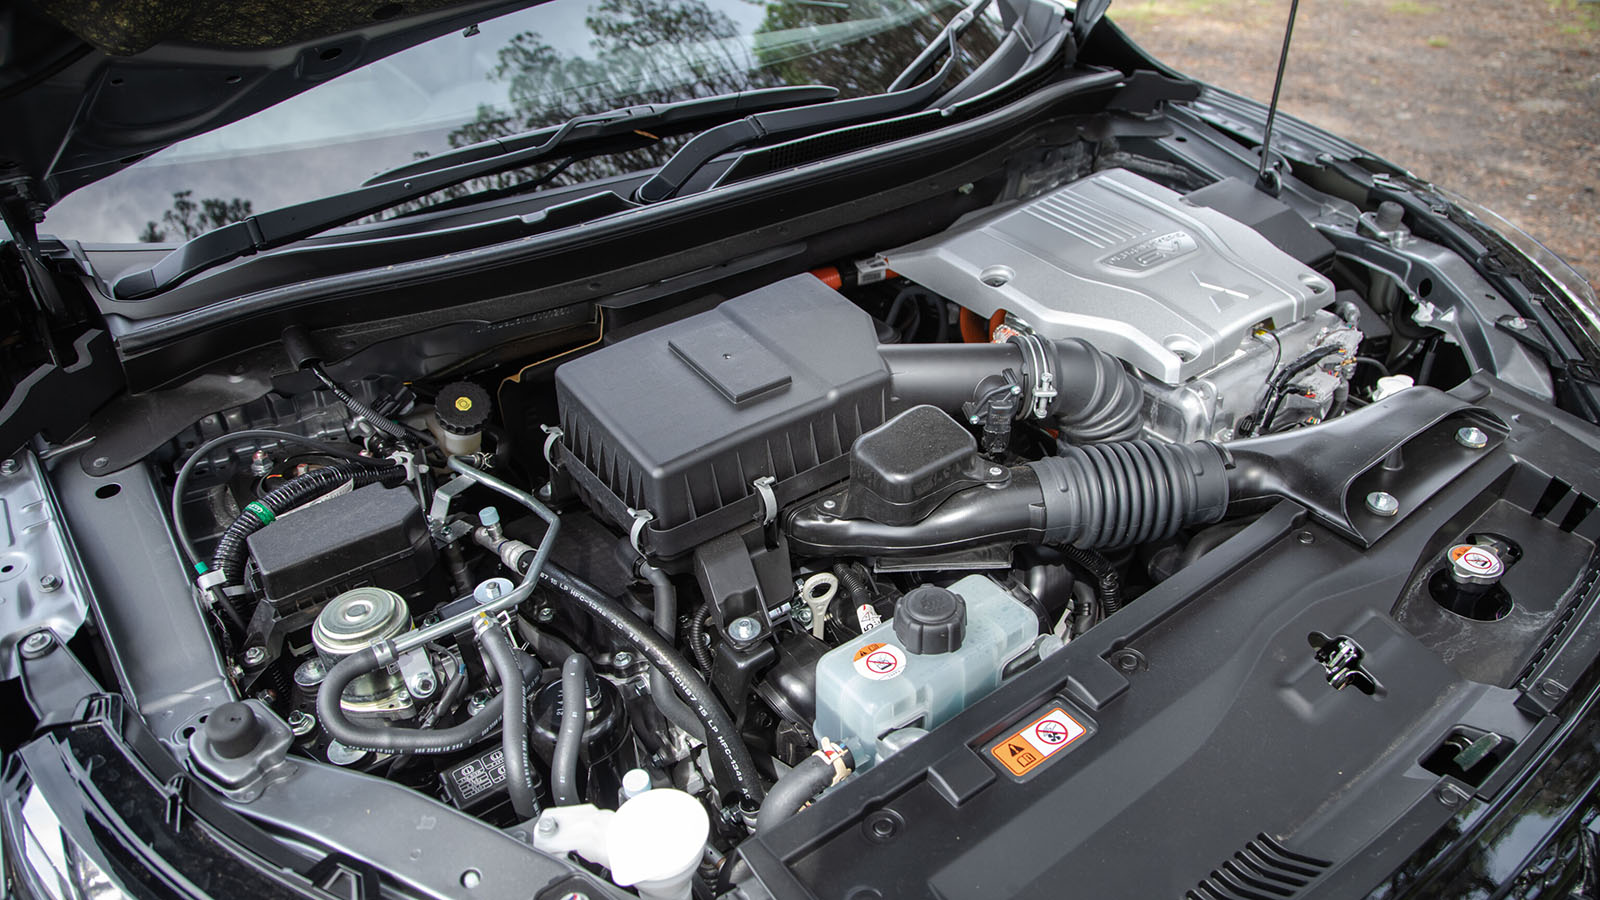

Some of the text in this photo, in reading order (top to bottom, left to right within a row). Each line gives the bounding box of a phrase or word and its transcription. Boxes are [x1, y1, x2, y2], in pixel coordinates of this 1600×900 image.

[611, 618, 624, 630] AC
[697, 704, 709, 717] 15
[707, 719, 719, 733] LP
[717, 735, 743, 782] HFC-134a
[741, 787, 752, 800] AC
